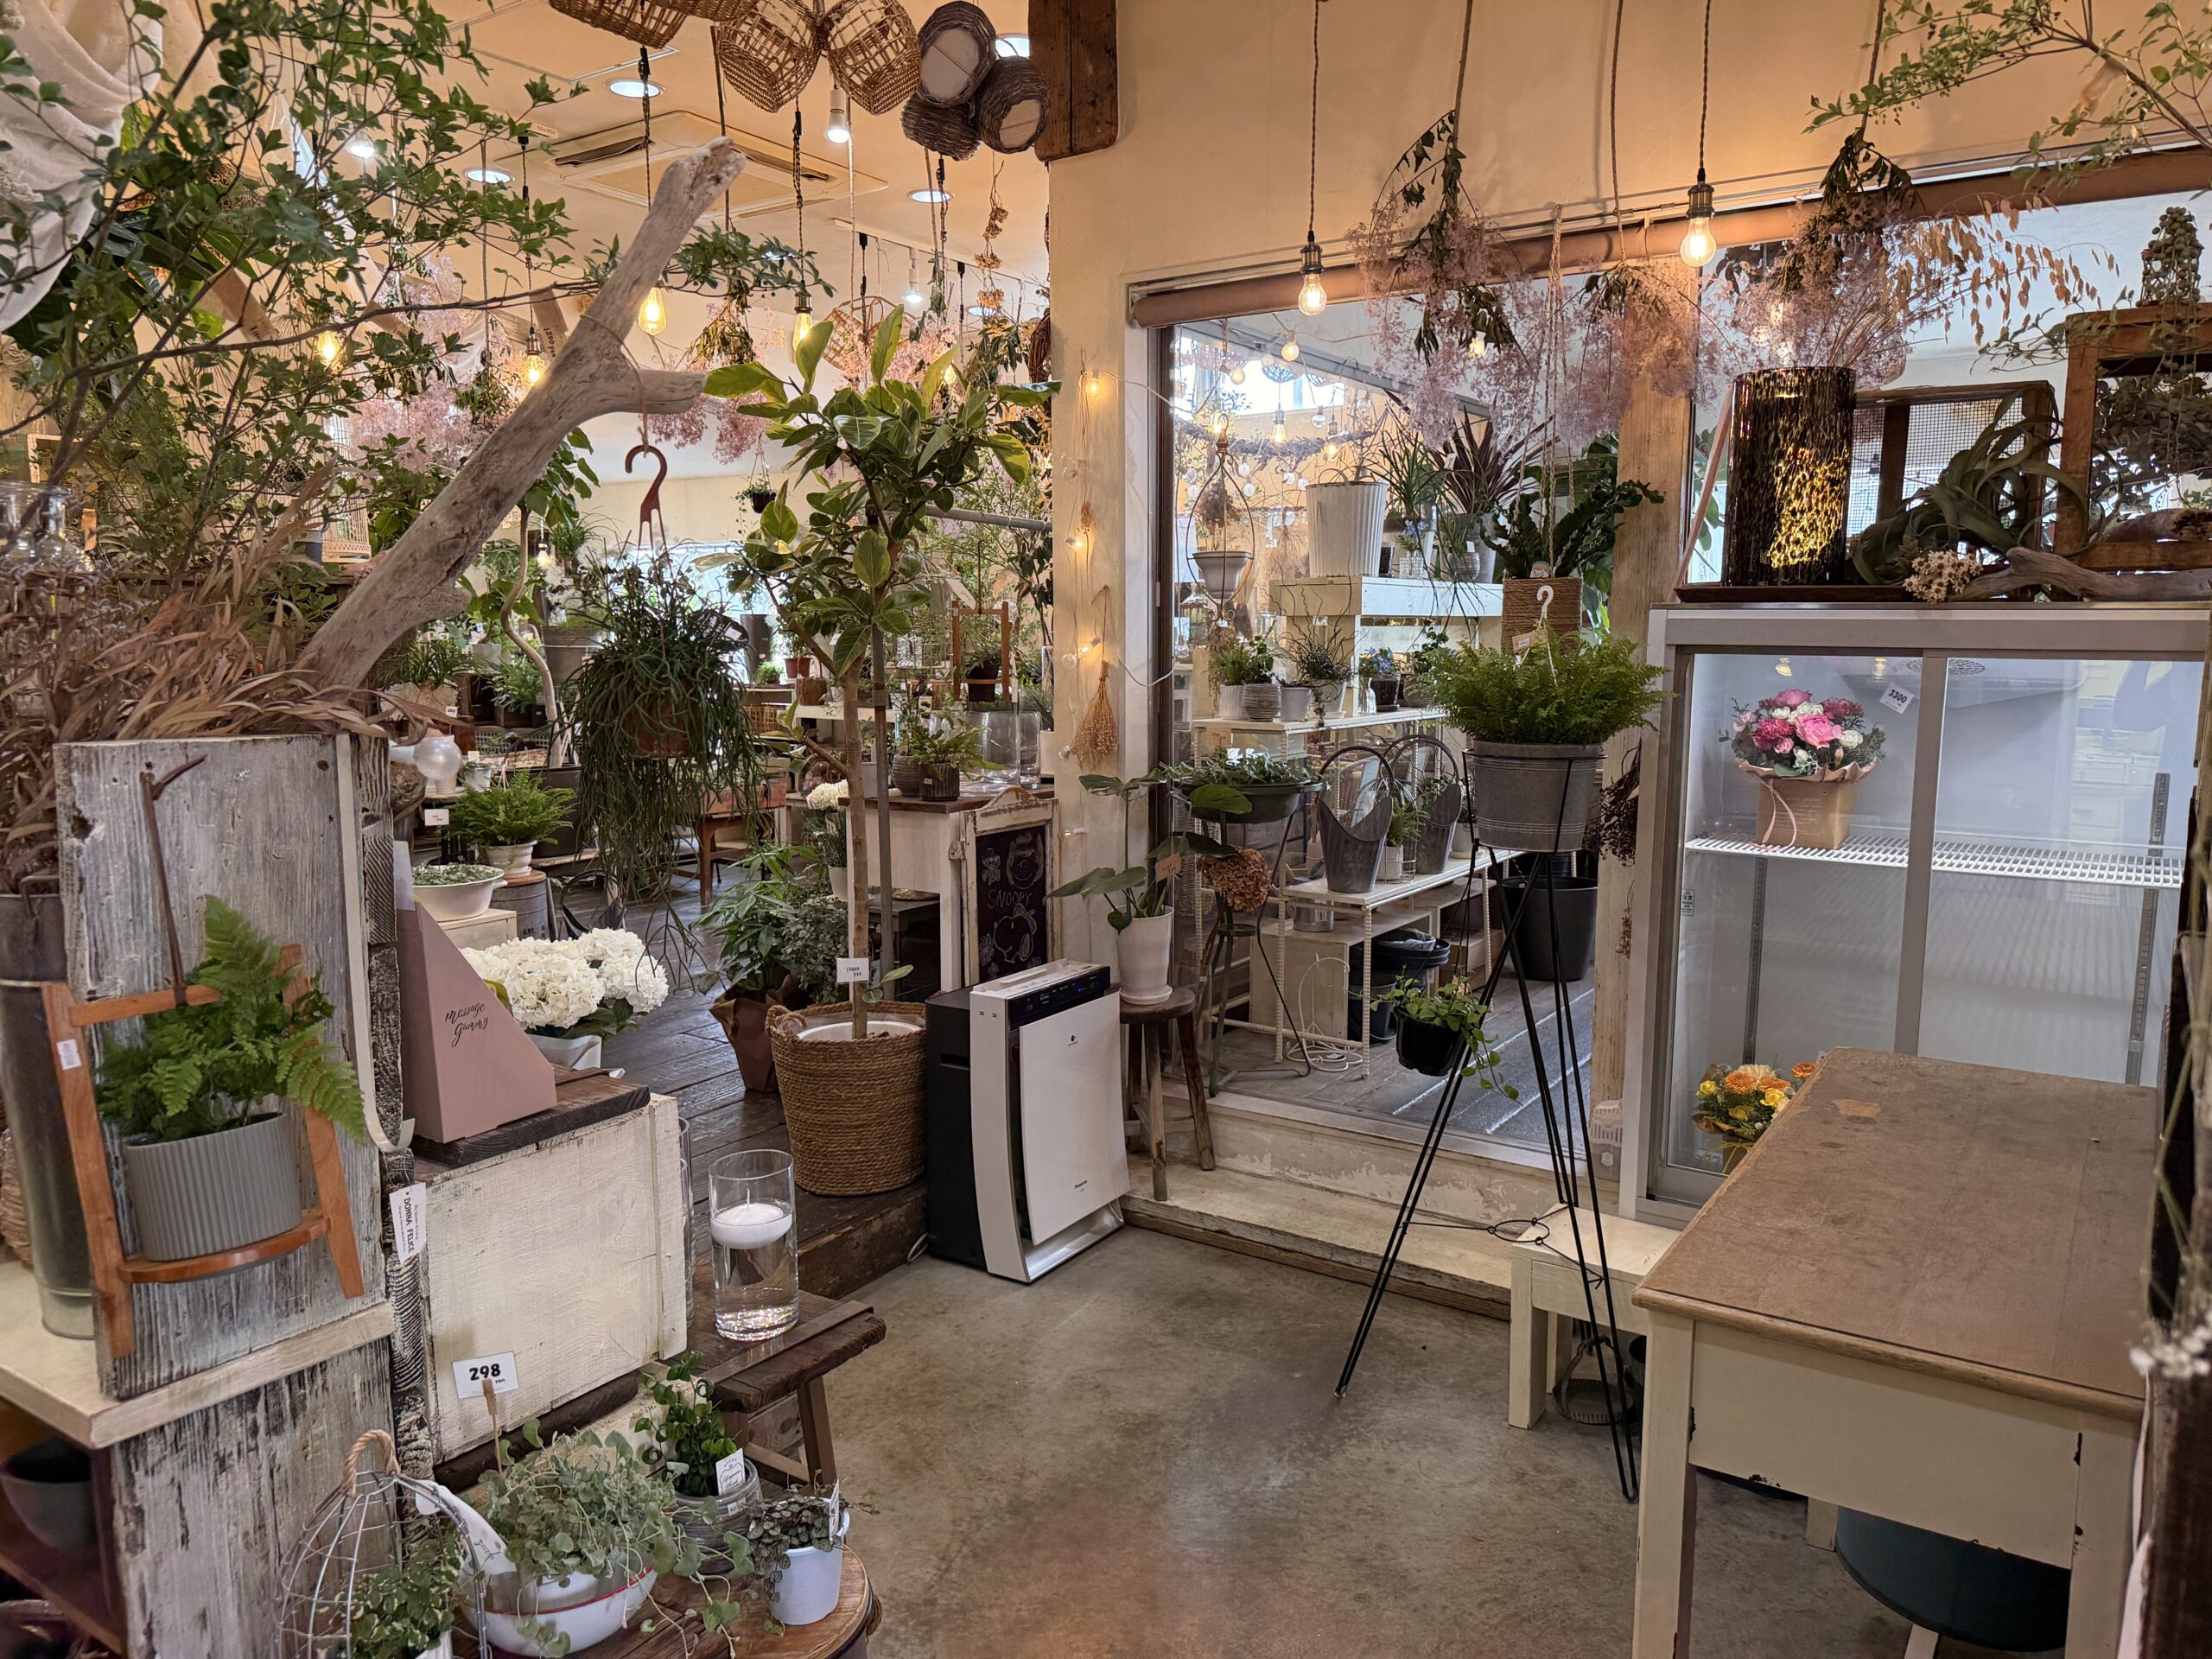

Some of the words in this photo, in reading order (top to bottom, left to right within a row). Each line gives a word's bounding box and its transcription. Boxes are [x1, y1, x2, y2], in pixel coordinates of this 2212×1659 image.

[1889, 689, 1908, 703] 3300
[988, 889, 1032, 909] SNOOPY
[404, 1197, 413, 1226] DONNA
[406, 1228, 415, 1254] FELICE
[469, 1363, 501, 1381] 298
